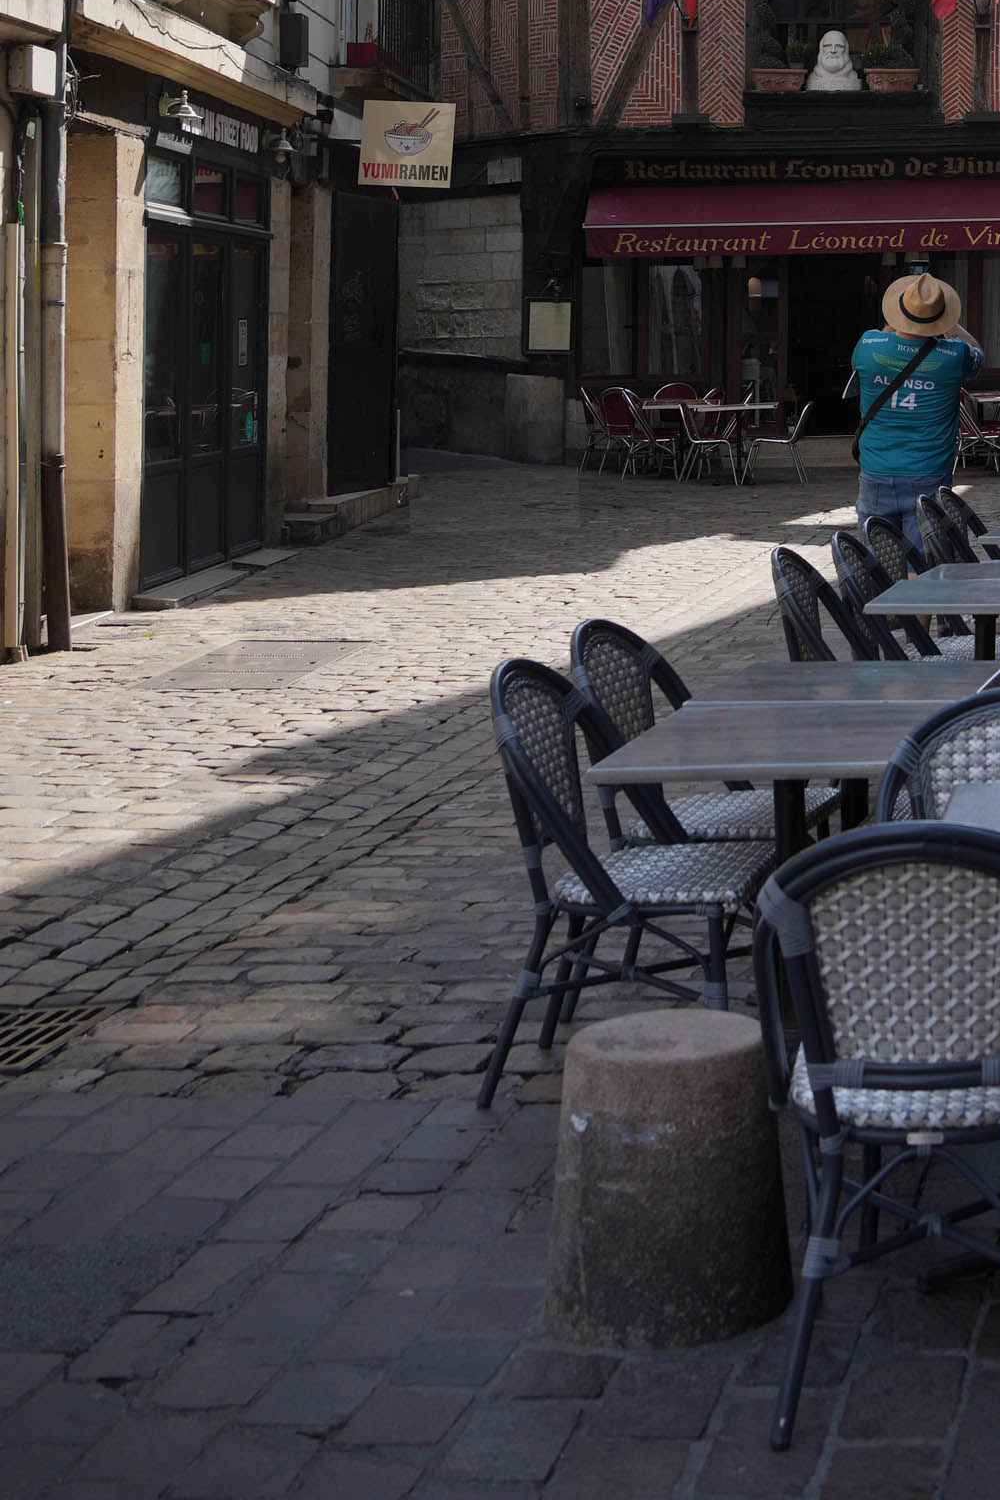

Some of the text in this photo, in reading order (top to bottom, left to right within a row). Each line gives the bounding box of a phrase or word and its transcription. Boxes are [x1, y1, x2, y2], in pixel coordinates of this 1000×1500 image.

[215, 113, 241, 149] STREET
[240, 122, 259, 154] FOOD
[361, 162, 449, 181] YUMIRAMEN
[623, 159, 777, 181] Restaurant
[784, 157, 895, 179] Léonard
[904, 156, 939, 177] de
[613, 230, 772, 253] Restaurant
[788, 228, 905, 250] Léonard
[920, 227, 949, 247] de
[897, 344, 920, 354] BOSS
[873, 375, 935, 390] ALNSO
[890, 390, 918, 411] 14
